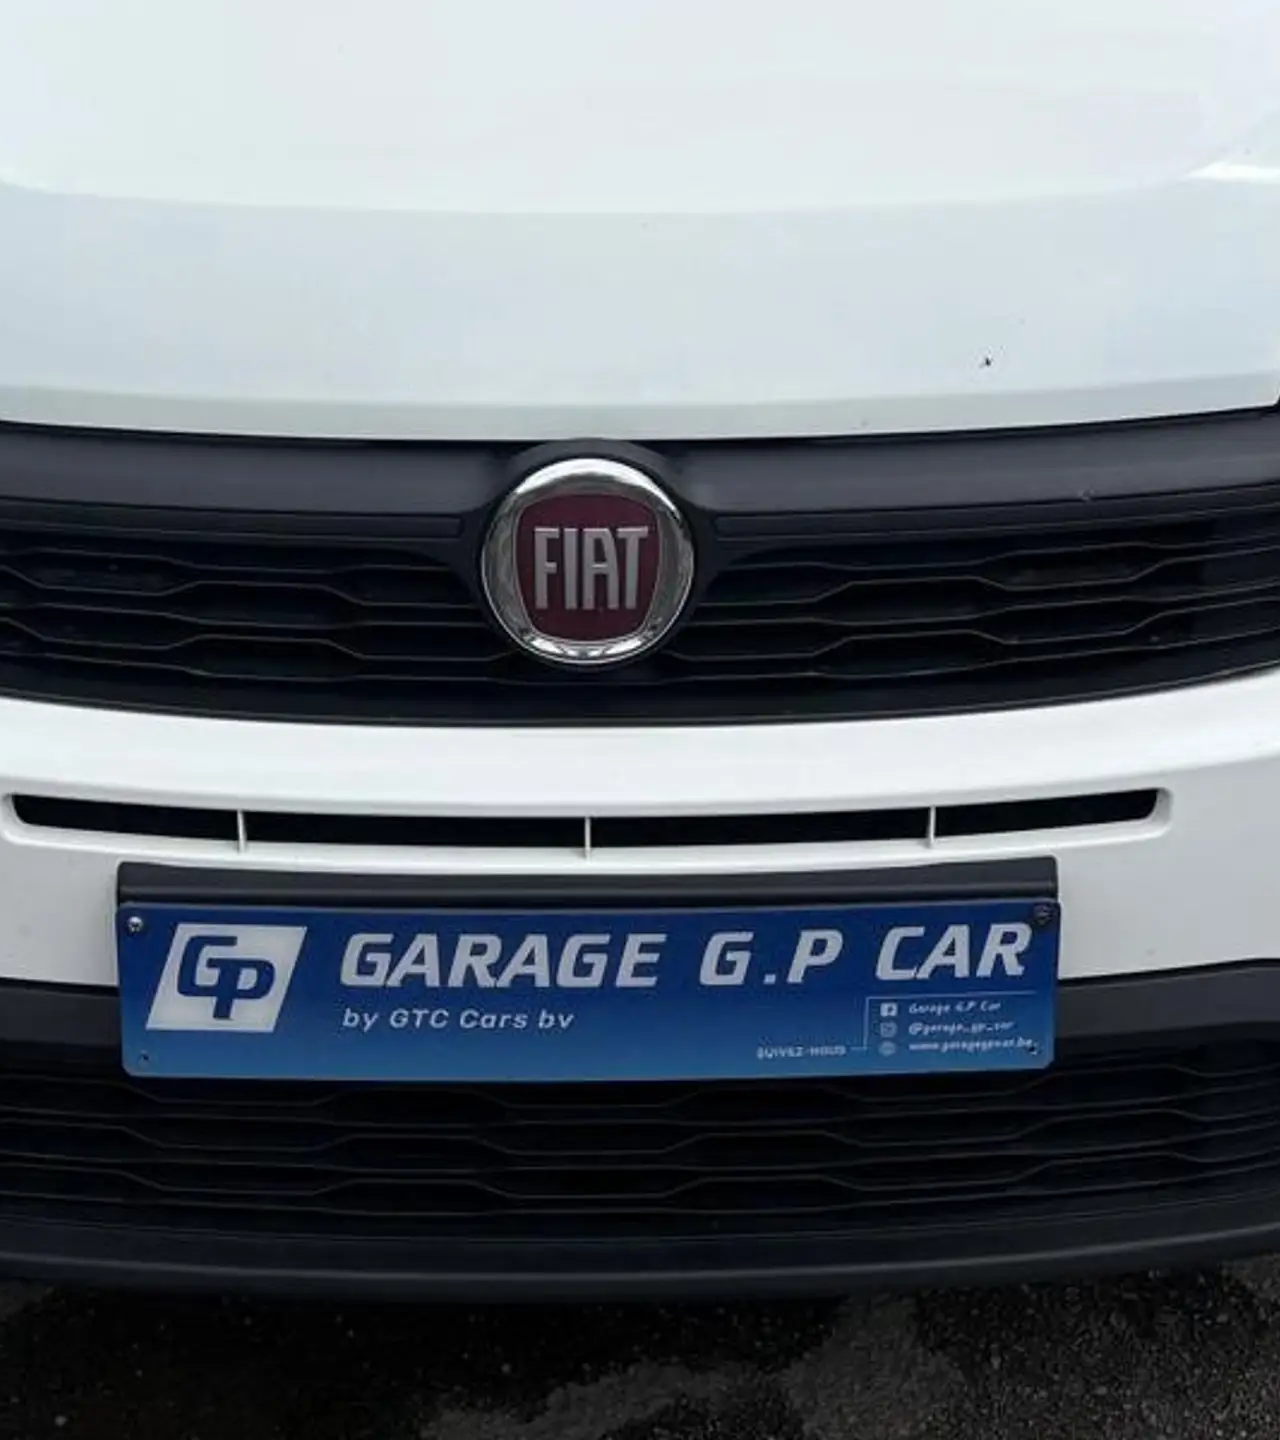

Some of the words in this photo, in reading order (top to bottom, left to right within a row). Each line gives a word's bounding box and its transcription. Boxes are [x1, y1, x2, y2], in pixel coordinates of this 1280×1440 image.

[534, 526, 649, 610] FIAT
[339, 931, 670, 989] GARAGE
[699, 928, 844, 987] G.P
[876, 922, 1033, 981] CAR
[342, 1007, 379, 1033] by
[389, 1007, 449, 1029] GTC
[459, 1007, 528, 1029] Cars
[538, 1007, 575, 1030] bv
